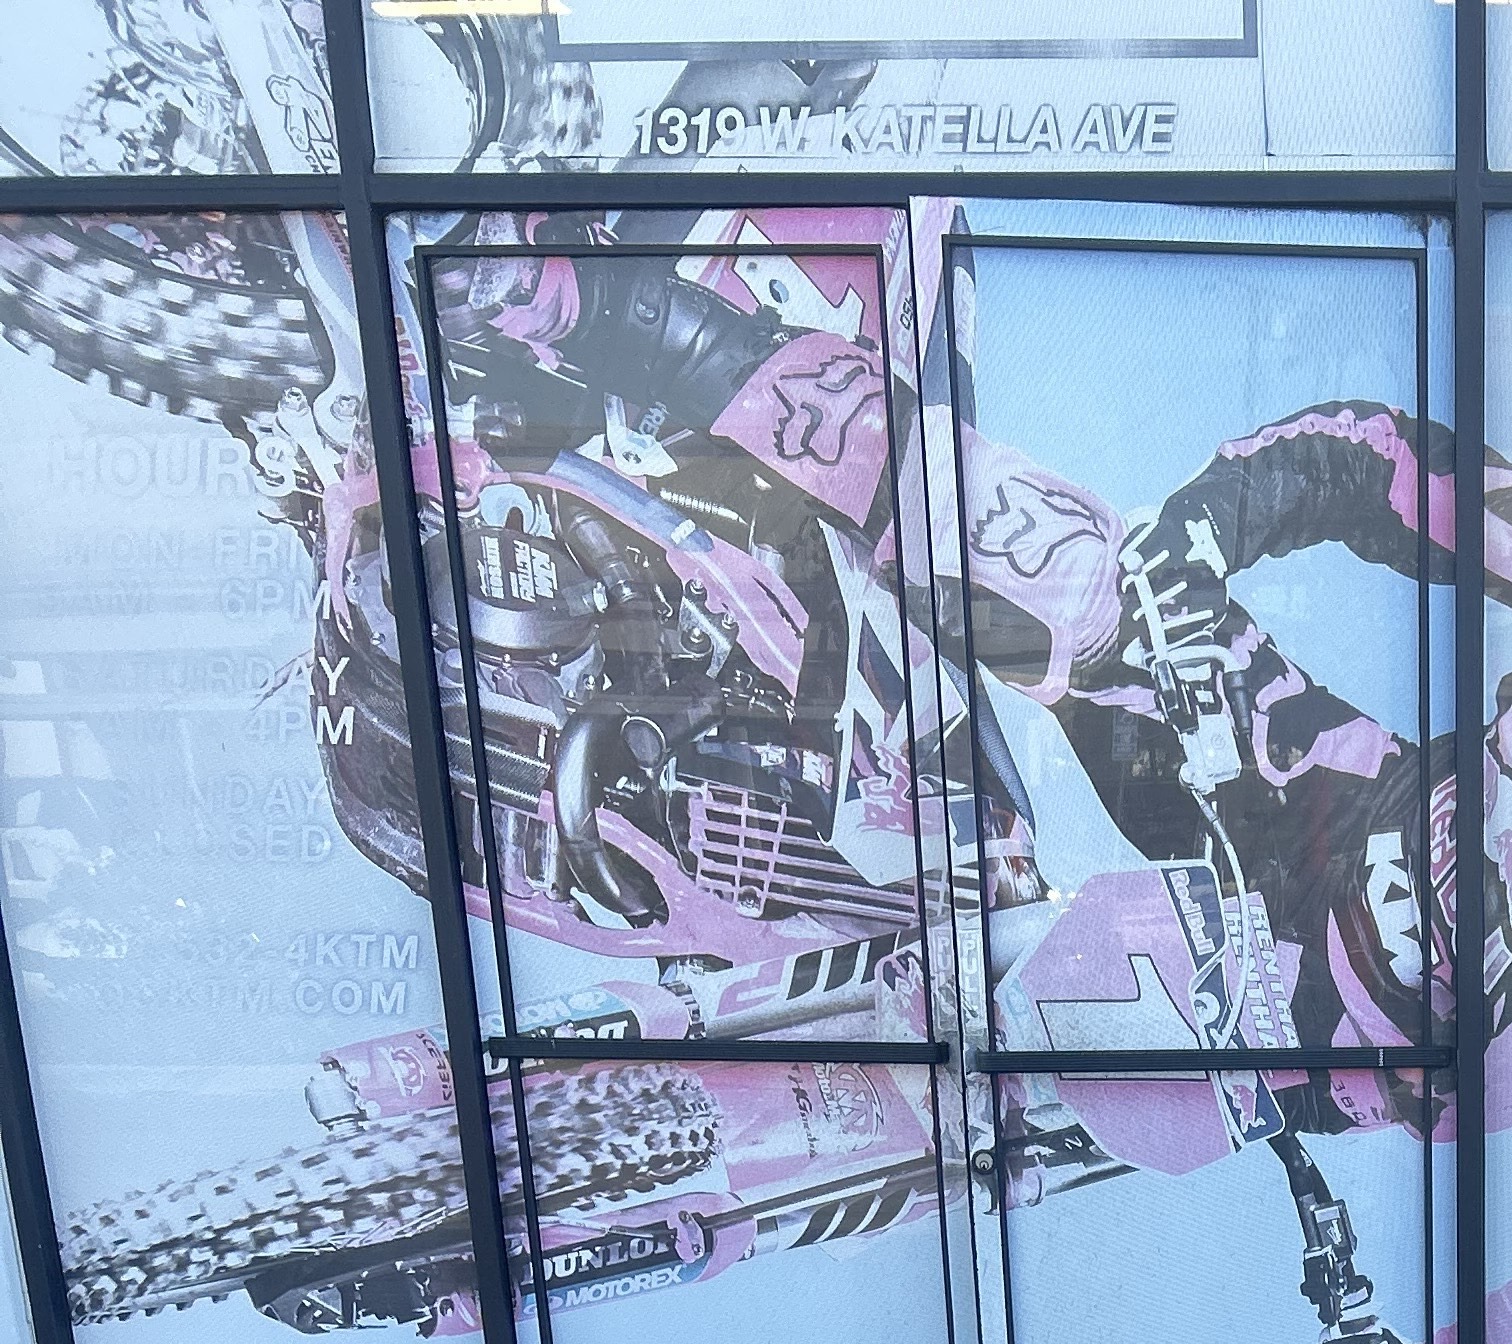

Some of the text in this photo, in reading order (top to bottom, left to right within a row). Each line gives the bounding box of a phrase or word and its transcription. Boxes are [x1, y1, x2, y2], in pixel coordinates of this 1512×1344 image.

[634, 105, 746, 156] 1319
[837, 102, 1067, 155] KATELLA
[1073, 101, 1176, 154] AVE
[48, 436, 298, 499] HOURS
[512, 540, 537, 604] FACTORY
[531, 547, 558, 599] KTM
[1365, 831, 1439, 989] KTM
[1248, 904, 1301, 1050] RENTHA
[565, 1264, 684, 1308] MOTOREX
